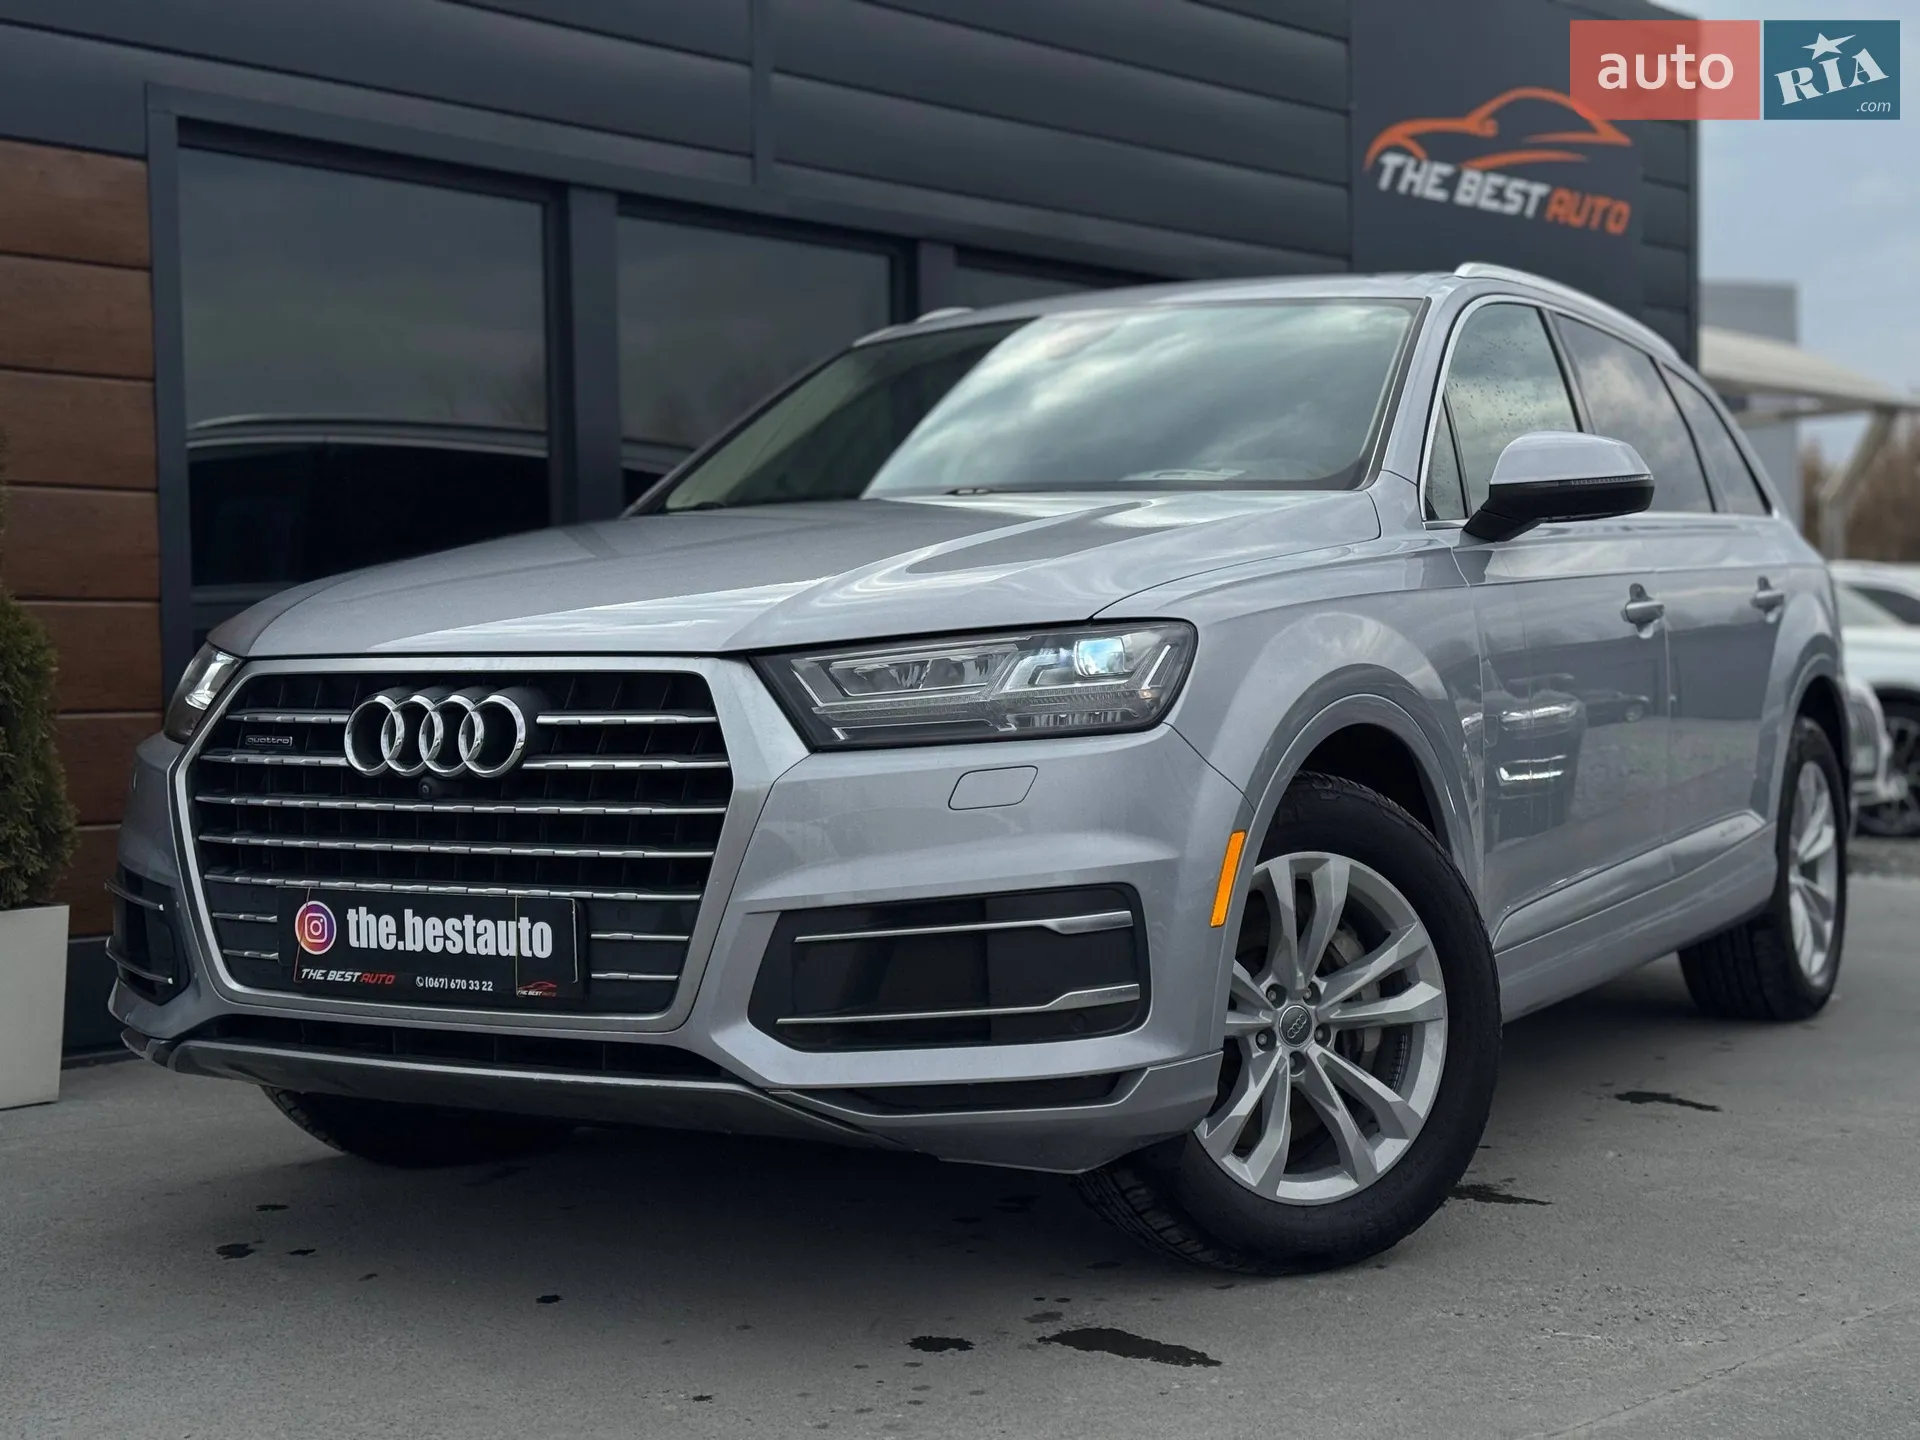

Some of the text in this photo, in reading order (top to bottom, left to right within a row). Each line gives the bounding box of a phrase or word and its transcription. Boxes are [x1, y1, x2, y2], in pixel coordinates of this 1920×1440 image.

[1378, 152, 1631, 235] THE BEST AUTO
[347, 906, 553, 959] the.bestauto
[301, 968, 396, 985] THE BEST AUTO
[425, 976, 493, 992] (067) 670 33 22
